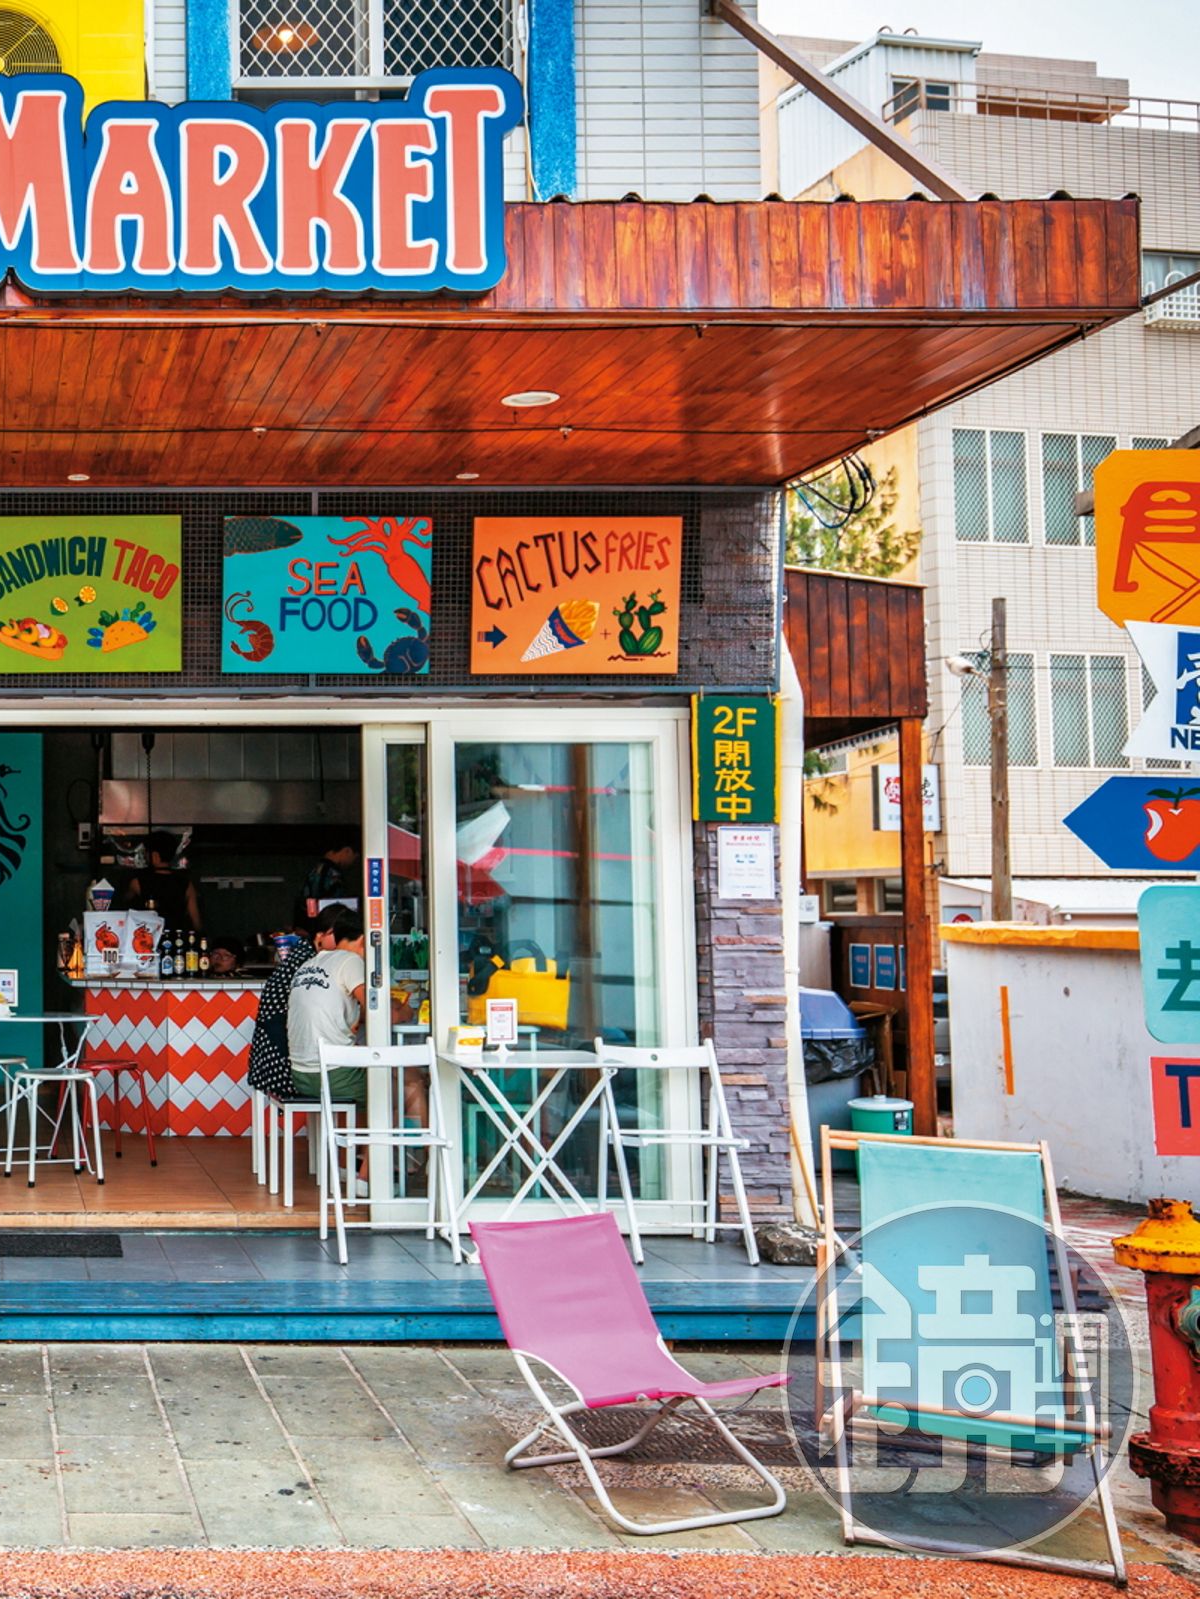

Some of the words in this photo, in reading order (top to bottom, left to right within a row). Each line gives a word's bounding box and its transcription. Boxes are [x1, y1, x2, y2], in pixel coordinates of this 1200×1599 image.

[112, 538, 180, 600] TACO
[287, 557, 368, 597] SEA
[475, 530, 603, 611] CACTUS
[604, 531, 672, 573] FRIES
[279, 597, 379, 633] FOOD
